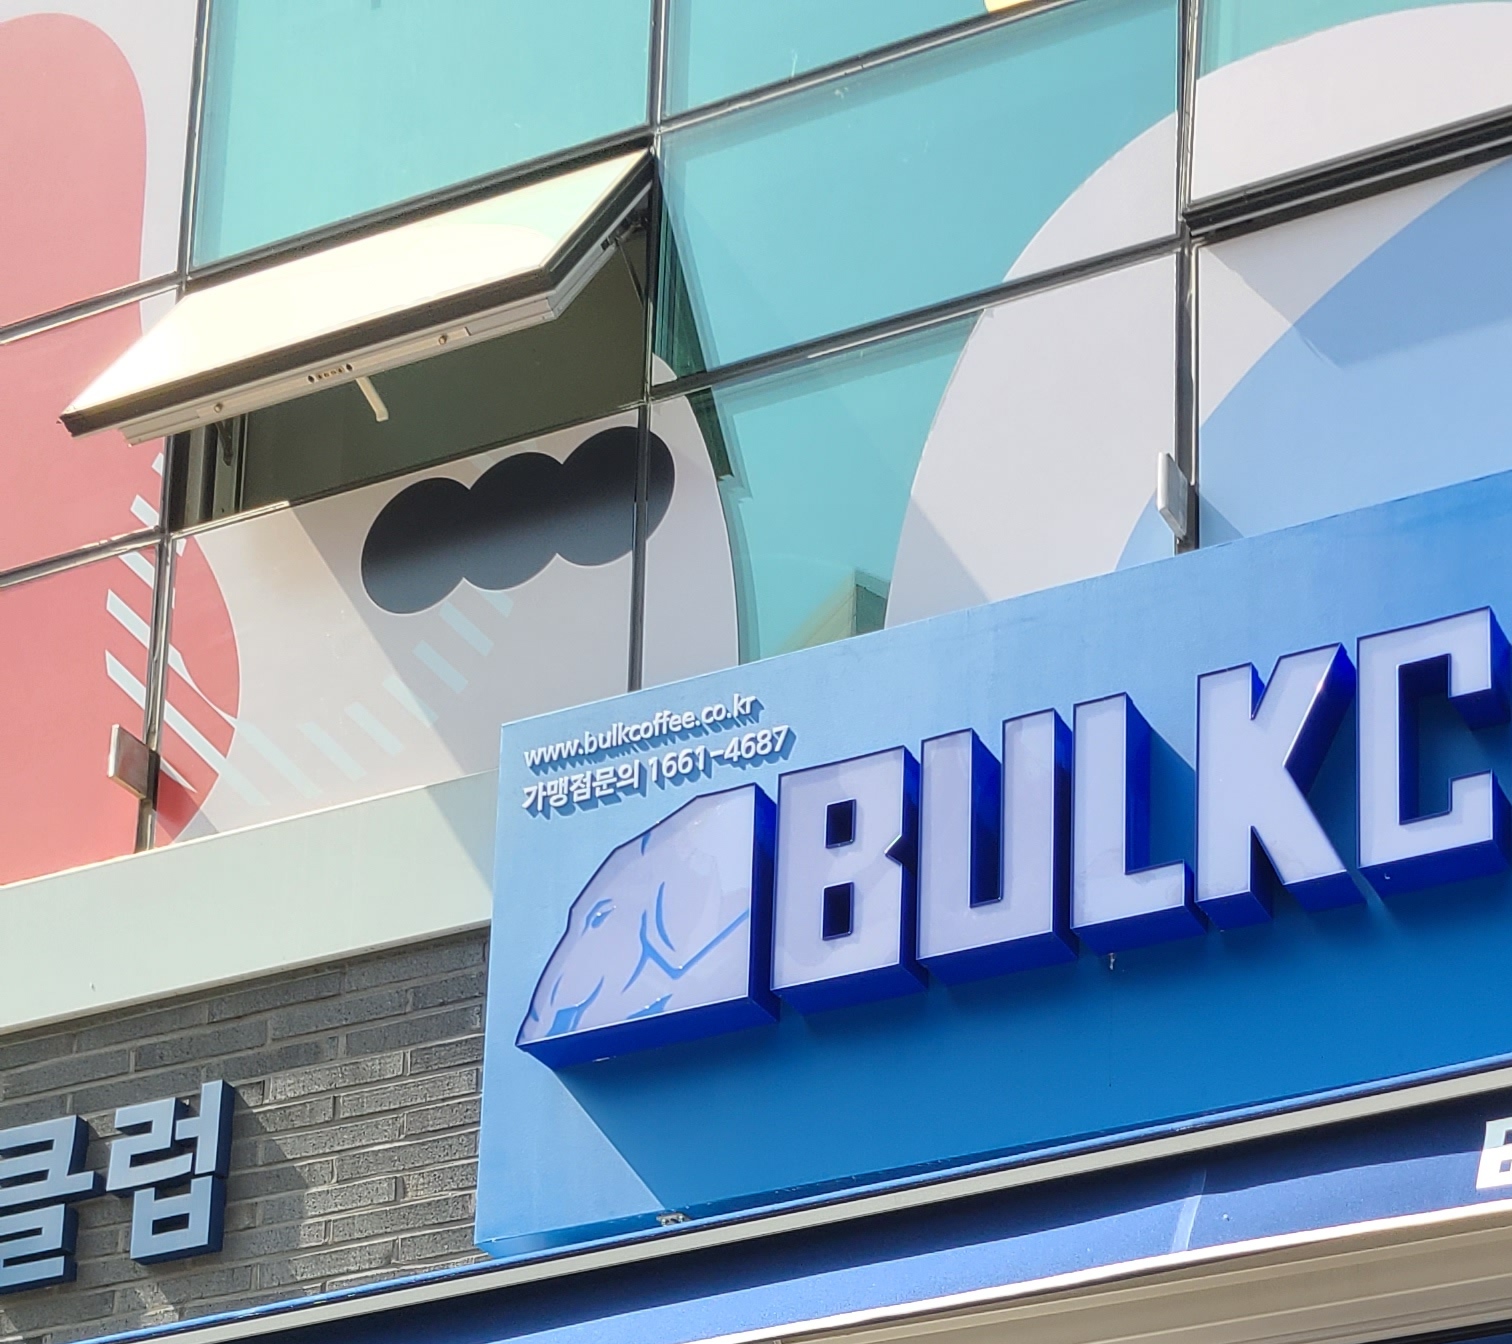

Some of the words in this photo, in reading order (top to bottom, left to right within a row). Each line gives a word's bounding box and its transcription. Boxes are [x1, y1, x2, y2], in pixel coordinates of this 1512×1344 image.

[521, 757, 641, 812] 가맹점문의
[647, 724, 790, 785] 1661-4687
[522, 692, 758, 768] www.bulkcoffee.co.kr
[0, 1079, 228, 1292] 클럽
